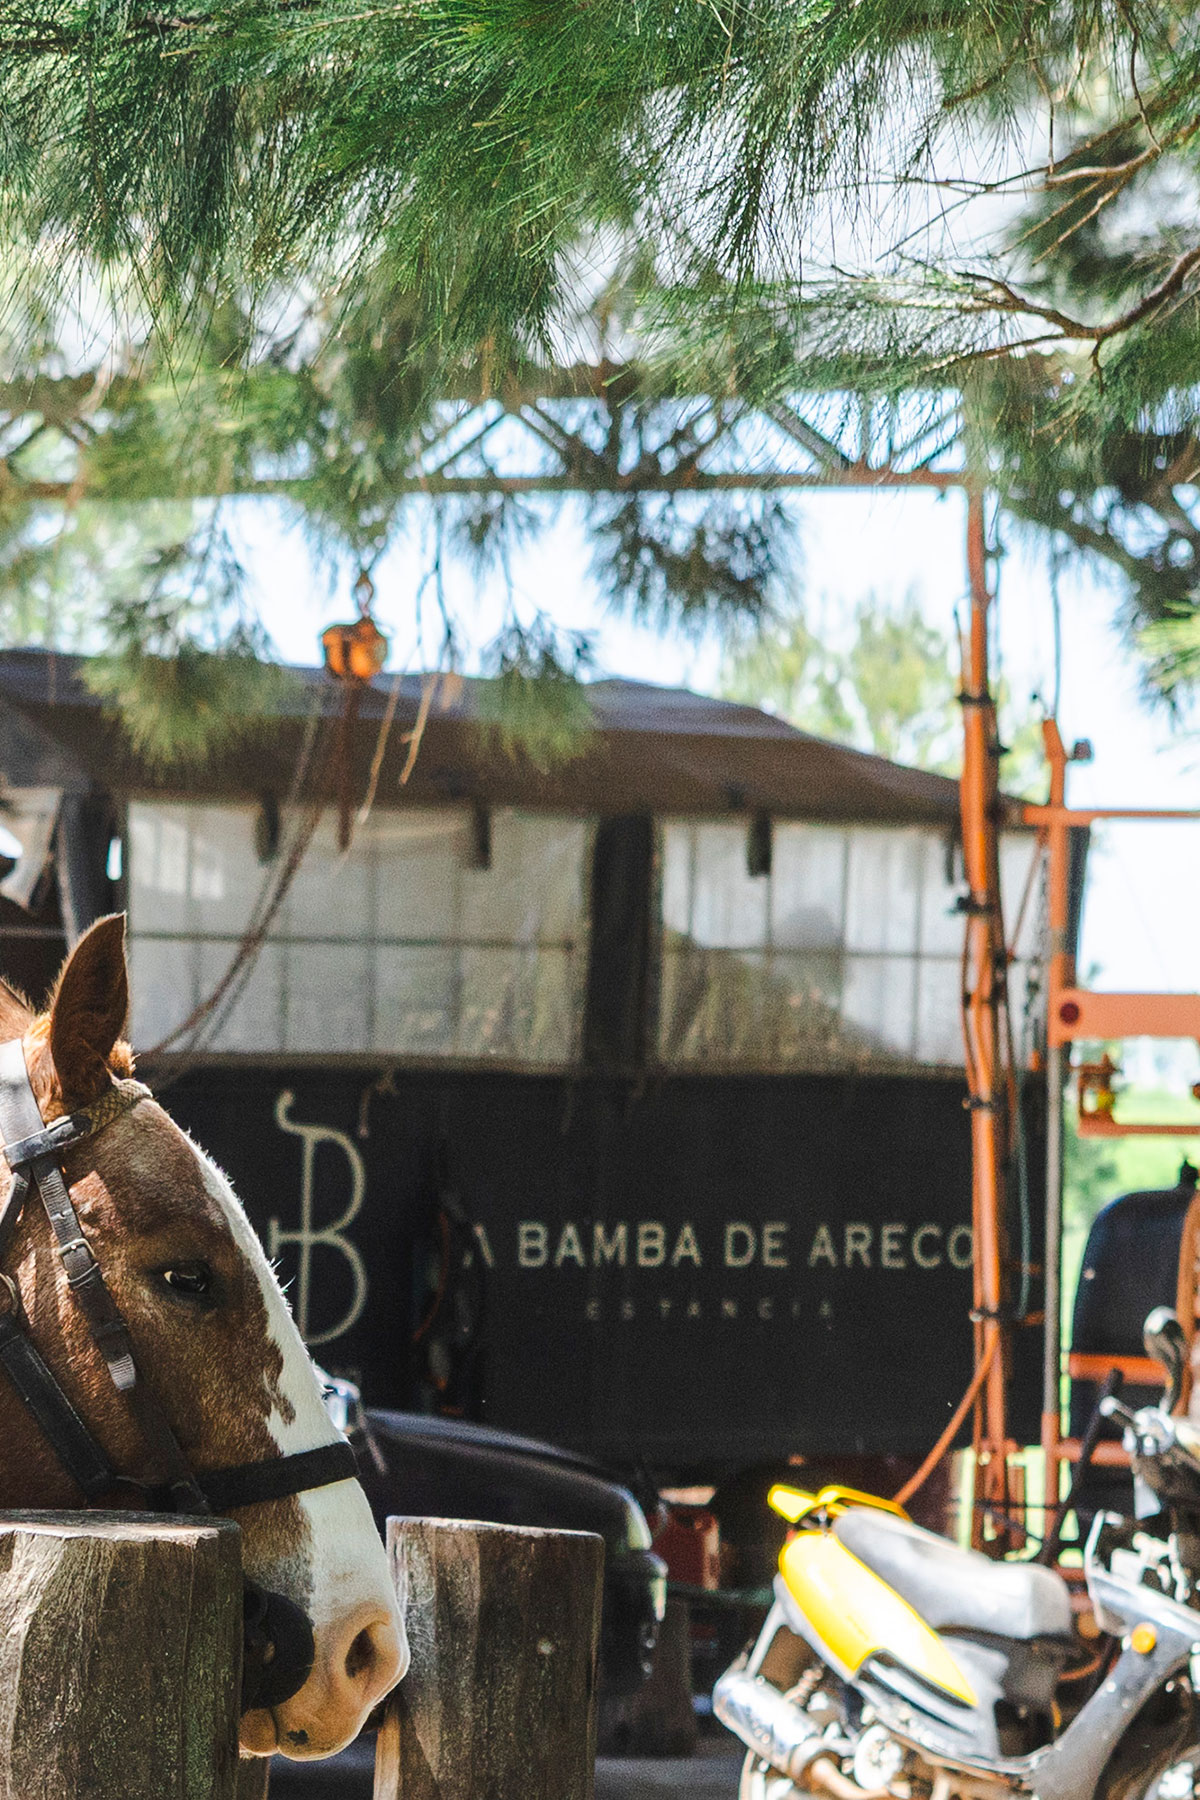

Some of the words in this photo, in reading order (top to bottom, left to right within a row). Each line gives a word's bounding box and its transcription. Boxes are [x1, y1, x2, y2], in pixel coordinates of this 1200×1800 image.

[517, 1221, 701, 1269] BAMBA
[724, 1221, 790, 1269] DE
[807, 1221, 974, 1269] ARECO
[586, 1299, 833, 1320] ESTANCIA
